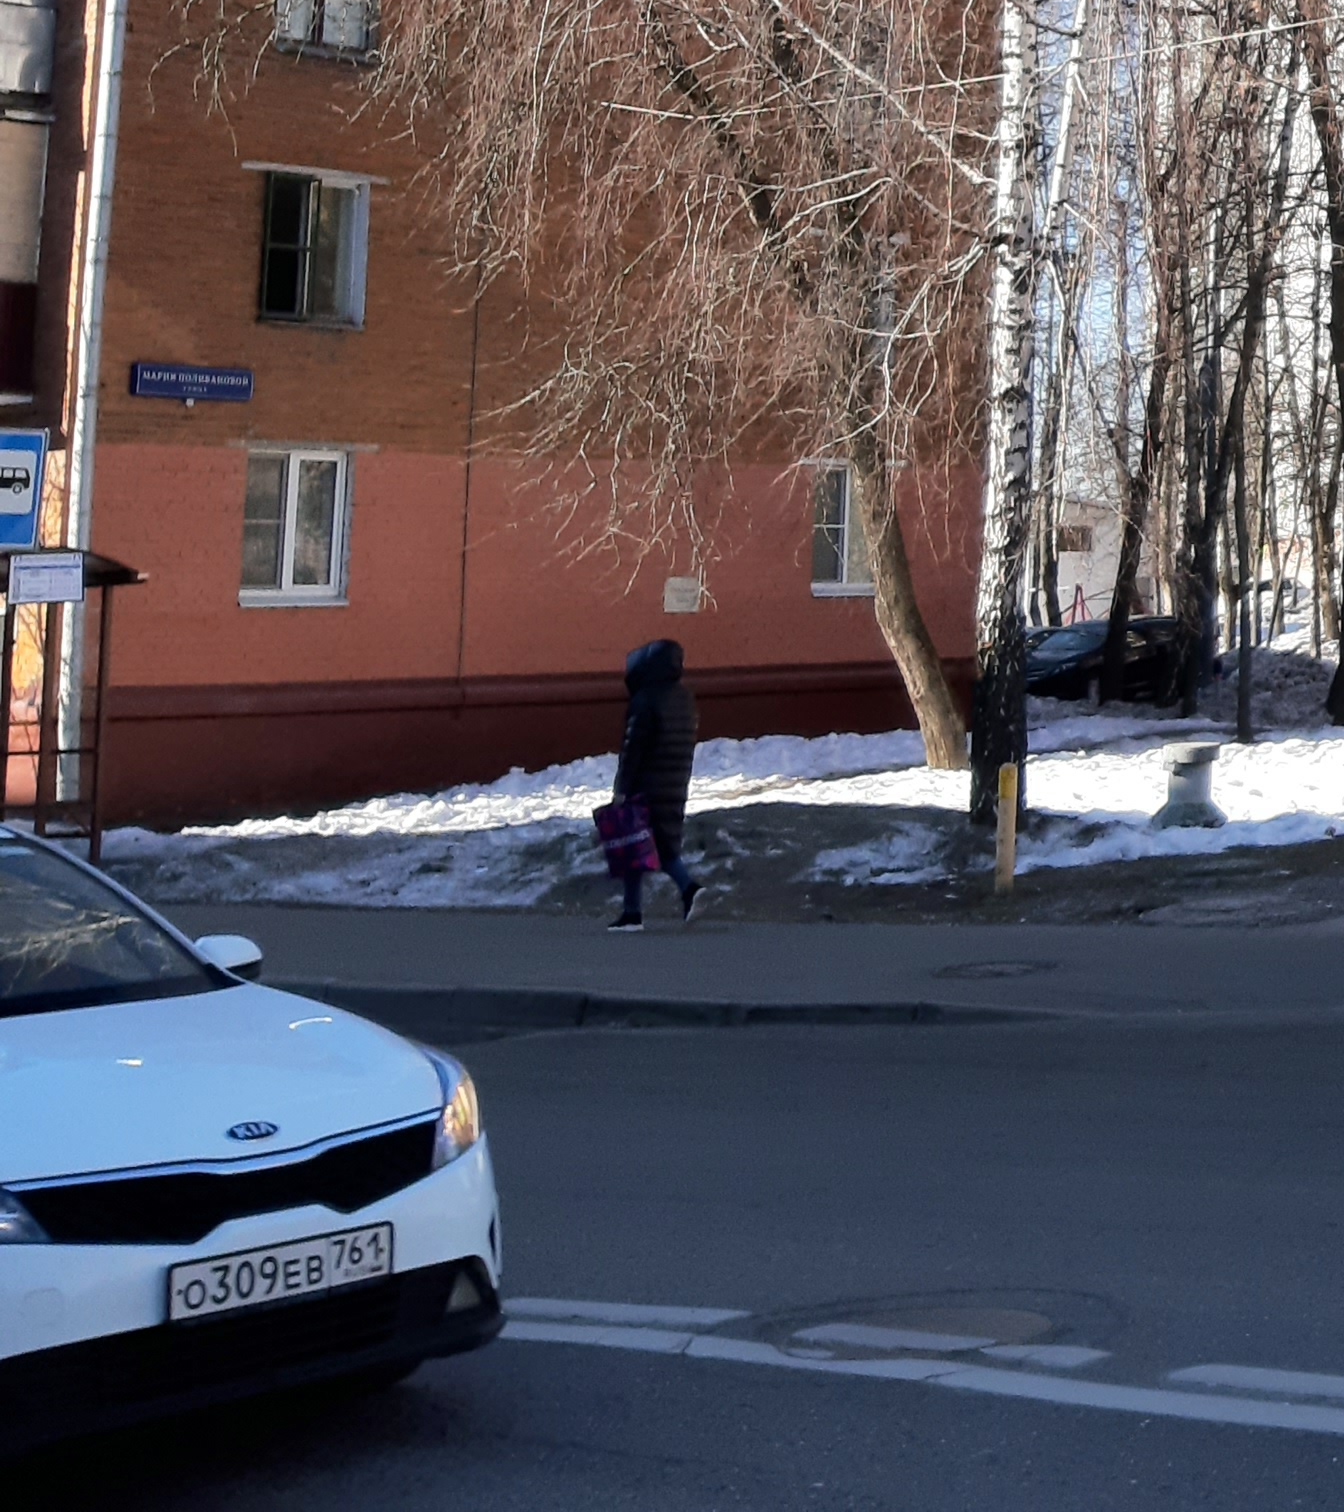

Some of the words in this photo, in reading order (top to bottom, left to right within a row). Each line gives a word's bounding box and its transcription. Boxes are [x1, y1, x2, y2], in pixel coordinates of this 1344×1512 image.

[143, 370, 176, 382] МАРИИ
[179, 372, 251, 386] ПОЛИВАНОВОЙ
[233, 1123, 275, 1138] KIA
[184, 1254, 324, 1310] О309ЕВ
[331, 1232, 381, 1269] 761
